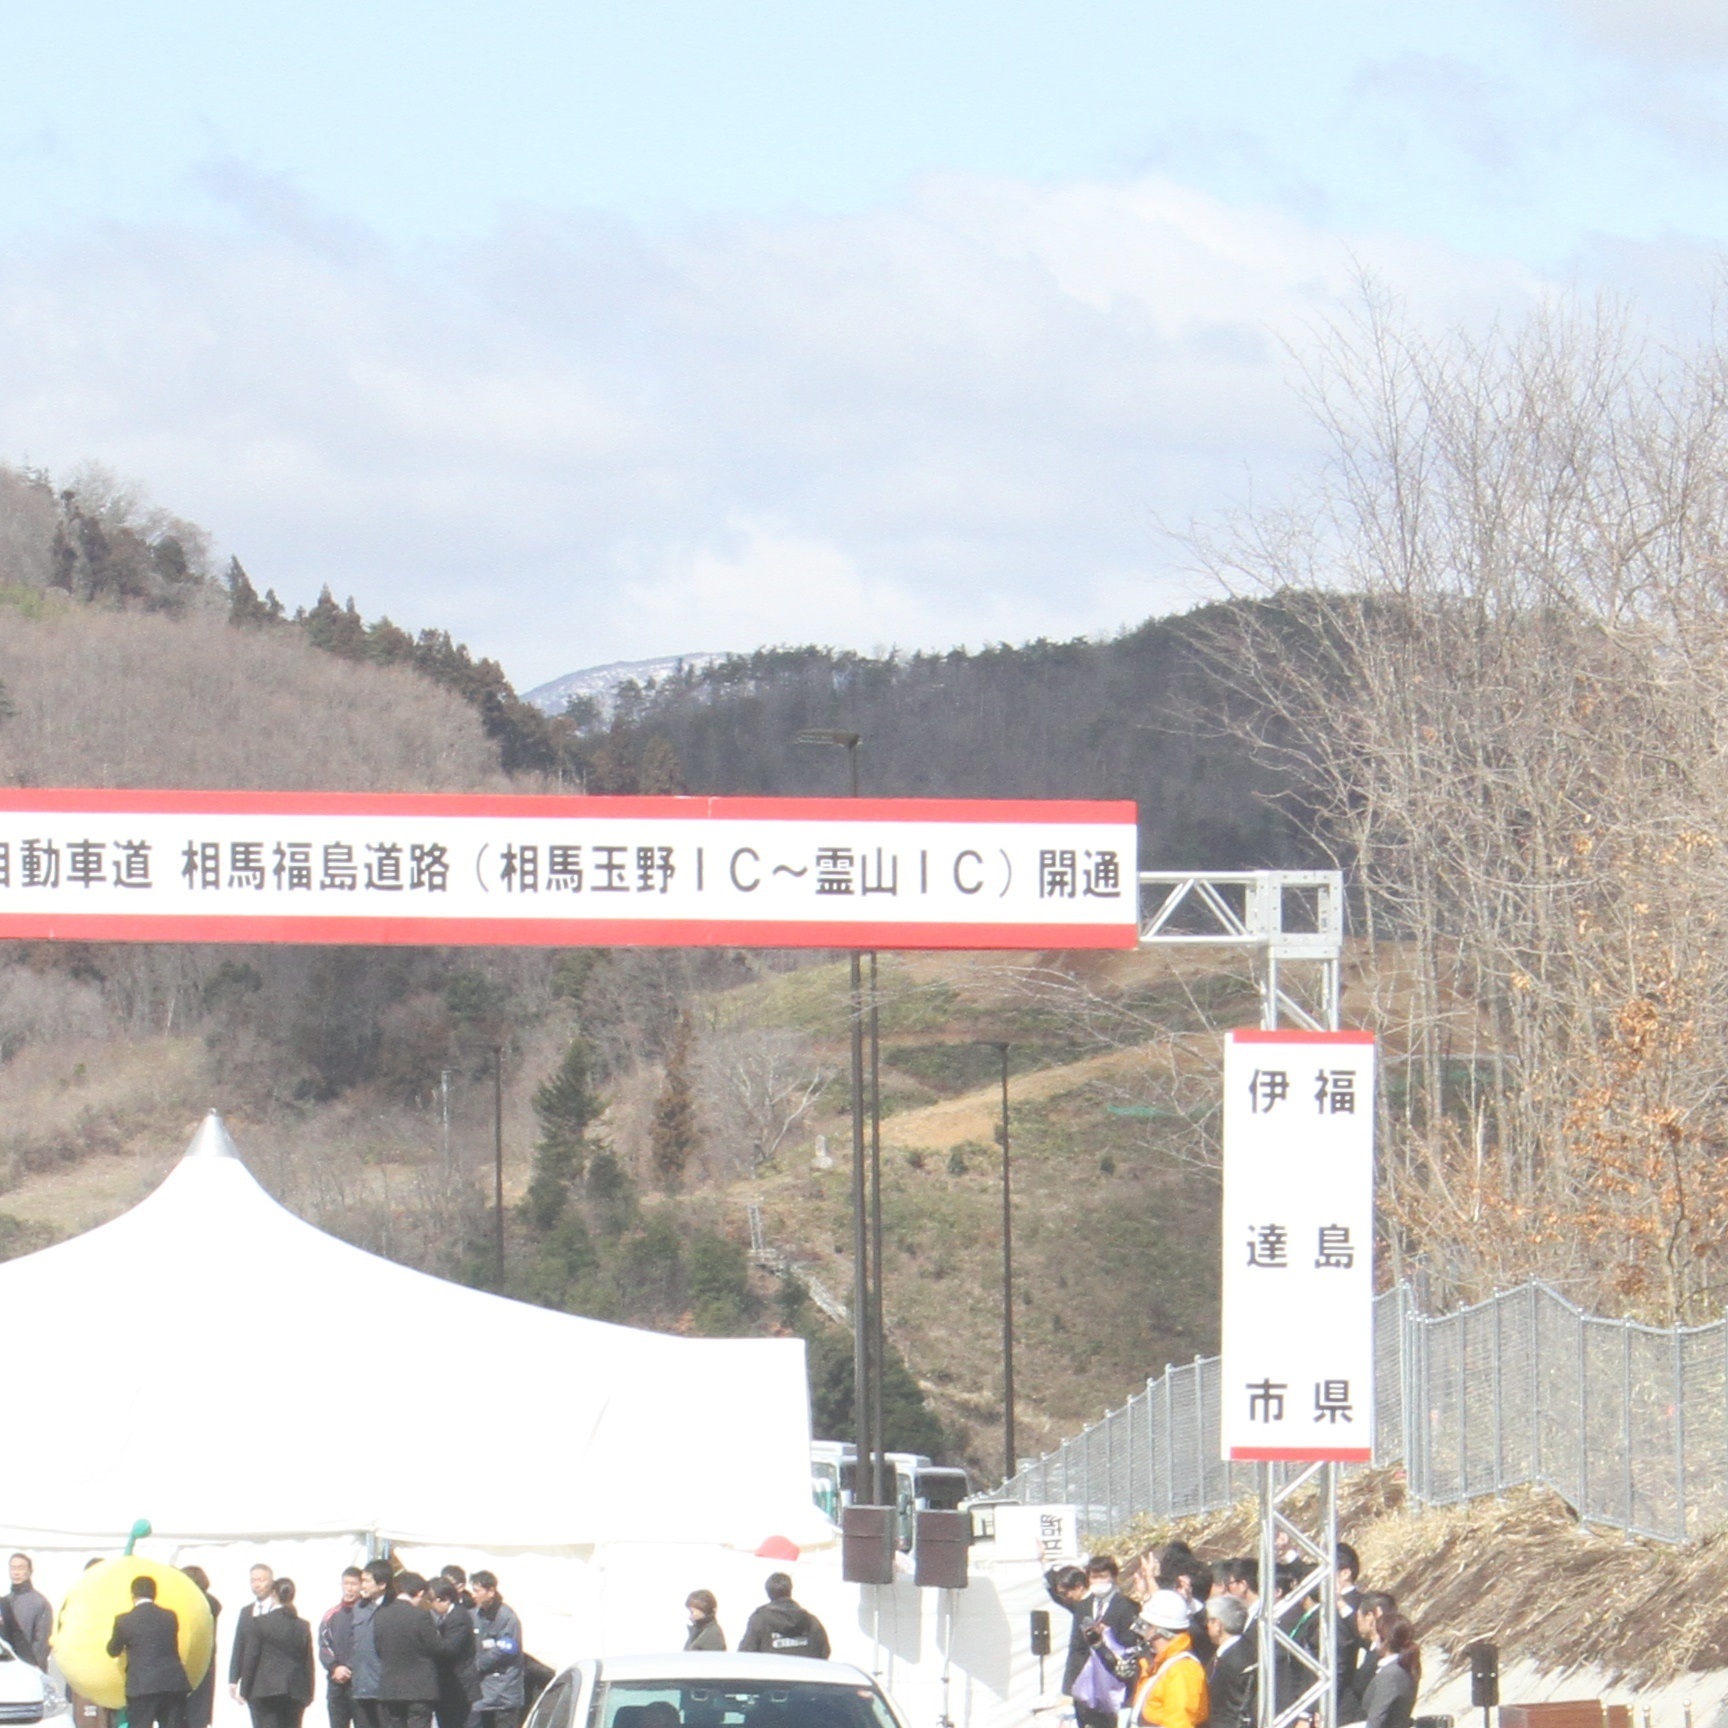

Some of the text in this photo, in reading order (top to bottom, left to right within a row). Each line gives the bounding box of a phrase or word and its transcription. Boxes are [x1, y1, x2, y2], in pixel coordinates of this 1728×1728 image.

[1246, 1069, 1290, 1425] 伊達市
[1313, 1069, 1357, 1425] 福島県
